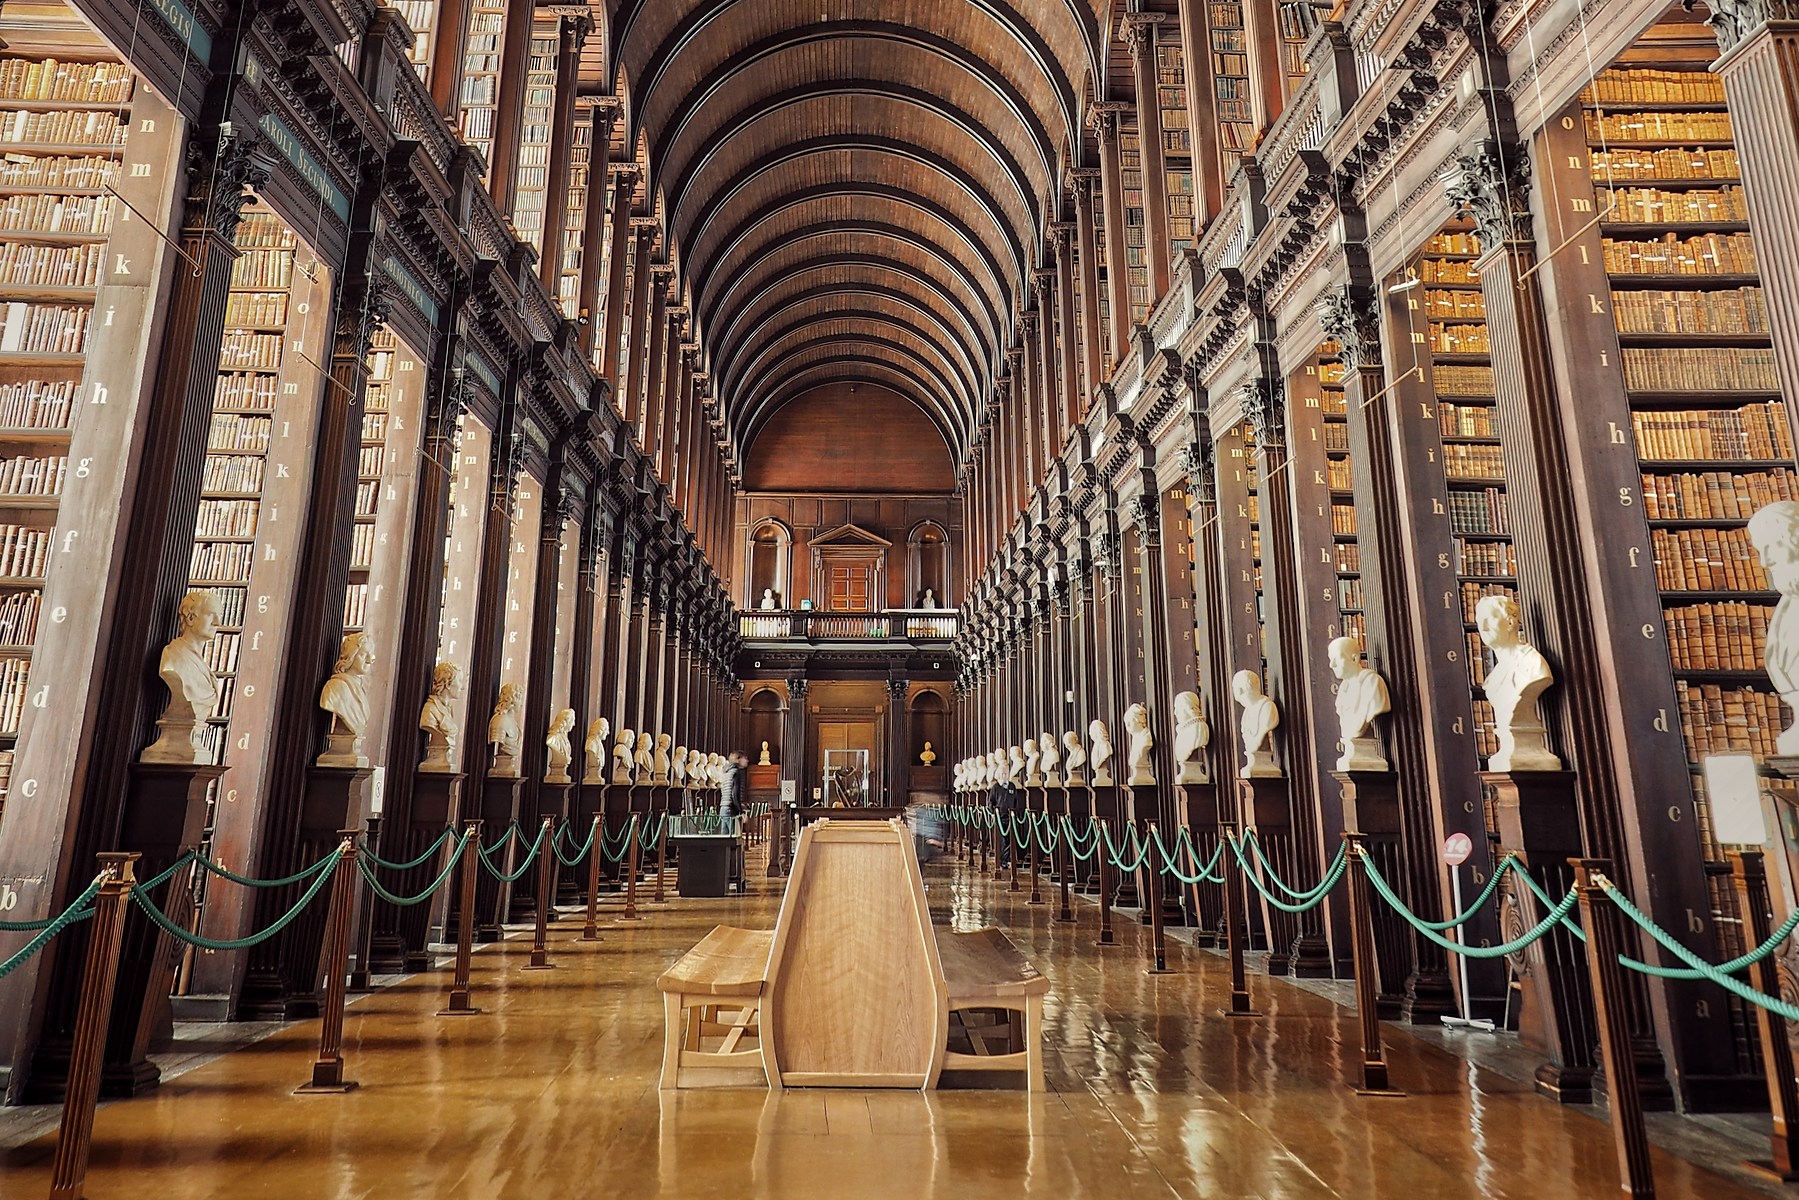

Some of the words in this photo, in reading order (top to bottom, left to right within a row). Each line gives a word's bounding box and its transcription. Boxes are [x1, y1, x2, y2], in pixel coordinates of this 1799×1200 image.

[140, 117, 155, 133] n
[1562, 116, 1574, 130] o
[130, 162, 151, 177] m
[1568, 156, 1582, 169] n
[1571, 198, 1592, 212] m
[1579, 245, 1590, 265] l
[114, 253, 131, 275] k
[297, 303, 310, 314] o
[1407, 298, 1419, 310] n
[1588, 294, 1605, 314] k
[104, 306, 116, 326] i
[1410, 332, 1425, 344] m
[399, 359, 414, 371] m
[1600, 350, 1609, 367] i
[1305, 365, 1315, 375] n
[91, 382, 108, 404] h
[284, 382, 298, 395] m
[397, 389, 403, 402] l
[1305, 397, 1319, 408] m
[1420, 403, 1434, 419] k
[281, 421, 289, 437] l
[394, 416, 404, 430] k
[467, 431, 476, 441] n
[1231, 427, 1239, 436] n
[1311, 428, 1317, 441] l
[1608, 422, 1626, 444] h
[390, 449, 396, 463] i
[465, 455, 477, 465] m
[1231, 448, 1243, 458] m
[1427, 448, 1435, 463] i
[76, 456, 93, 478] g
[276, 463, 290, 478] k
[1235, 470, 1241, 481] l
[1314, 470, 1326, 484] k
[464, 477, 469, 489] l
[386, 485, 396, 500] h
[1171, 489, 1183, 499] m
[1619, 486, 1633, 507] g
[269, 503, 277, 522] i
[460, 504, 469, 517] k
[1238, 504, 1248, 518] k
[1317, 503, 1323, 516] i
[1432, 498, 1445, 515] h
[61, 530, 78, 553] f
[456, 542, 462, 553] i
[516, 542, 526, 553] k
[1240, 537, 1246, 550] i
[264, 544, 276, 561] h
[1178, 543, 1186, 555] k
[1320, 548, 1331, 563] h
[1438, 552, 1450, 569] g
[1628, 546, 1640, 568] f
[1242, 569, 1250, 582] h
[453, 577, 462, 591] h
[1323, 587, 1332, 601] g
[1443, 591, 1453, 609] f
[258, 595, 270, 613] g
[1181, 597, 1189, 609] h
[1245, 602, 1252, 614] g
[52, 606, 67, 623] e
[450, 617, 459, 629] g
[1327, 623, 1336, 639] f
[1641, 623, 1655, 639] e
[251, 631, 264, 650] f
[448, 640, 457, 654] f
[1446, 650, 1457, 662] e
[32, 685, 50, 708] d
[243, 685, 255, 697] e
[1452, 717, 1464, 735] d
[1653, 709, 1669, 733] d
[238, 733, 250, 750] d
[21, 778, 38, 798] c
[227, 790, 238, 802] c
[1463, 801, 1474, 814] c
[1668, 805, 1681, 822] c
[1471, 865, 1484, 885] b
[0, 884, 17, 911] b
[1686, 908, 1704, 934] b
[1696, 1000, 1710, 1019] a
